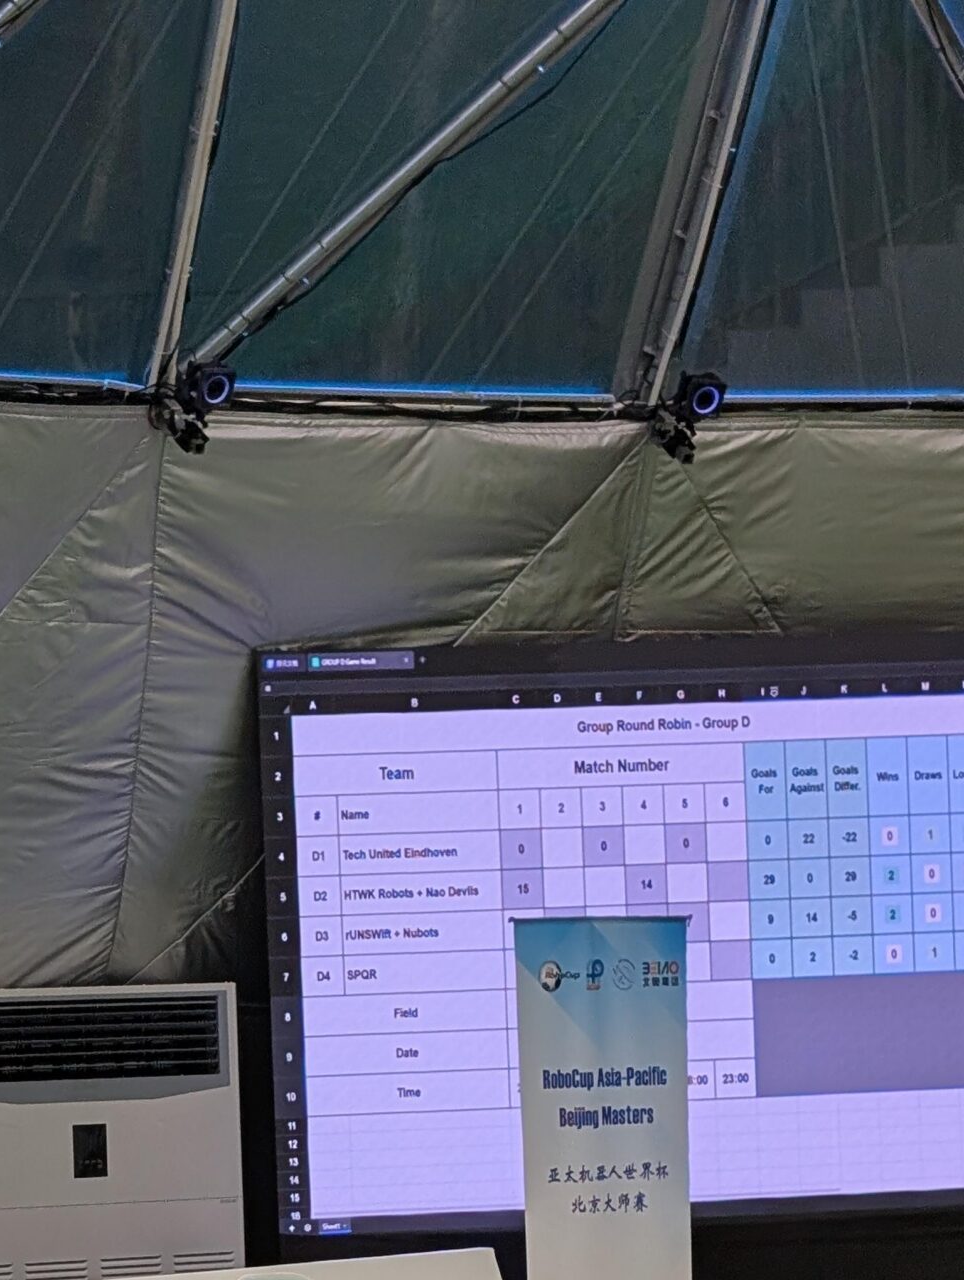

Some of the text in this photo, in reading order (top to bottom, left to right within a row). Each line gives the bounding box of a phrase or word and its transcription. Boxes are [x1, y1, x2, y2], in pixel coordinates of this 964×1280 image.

[800, 685, 806, 696] J
[841, 684, 848, 694] K
[882, 683, 888, 693] L
[921, 681, 930, 691] M
[554, 693, 561, 702] D
[596, 692, 602, 701] E
[637, 690, 643, 700] F
[677, 690, 685, 699] G
[718, 689, 726, 698] H
[411, 698, 418, 707] B
[512, 694, 520, 704] C
[309, 701, 316, 710] A
[577, 721, 613, 734] Group
[617, 719, 654, 732] Round
[658, 718, 692, 730] Robin
[702, 717, 738, 730] Group
[741, 716, 750, 727] D
[274, 732, 279, 740] 1
[574, 758, 669, 774] Match Number
[833, 766, 859, 776] Goals
[275, 772, 282, 781] 2
[379, 766, 414, 780] Team
[751, 768, 777, 779] Goals
[792, 767, 818, 777] Goals
[876, 771, 899, 782] Wins
[914, 770, 942, 781] Draws
[758, 784, 774, 794] For
[789, 782, 824, 795] Against
[834, 781, 861, 792] Differ.
[600, 801, 606, 812] 3
[641, 800, 647, 810] 4
[682, 798, 688, 808] 5
[723, 797, 729, 807] 6
[517, 804, 522, 814] 1
[558, 803, 564, 813] 2
[277, 812, 283, 822] 3
[341, 809, 369, 821] Name
[765, 835, 771, 845] 0
[803, 834, 815, 844] 22
[842, 832, 857, 843] -22
[887, 831, 893, 841] 0
[928, 830, 933, 840] 1
[601, 841, 607, 851] 0
[683, 838, 689, 848] 0
[343, 847, 458, 860] Tech United Eindhoven
[519, 844, 525, 854] 0
[278, 852, 284, 861] 4
[312, 851, 325, 861] D1
[807, 873, 813, 883] 0
[845, 871, 857, 882] 29
[888, 870, 895, 881] 2
[929, 868, 935, 879] 0
[763, 874, 775, 885] 29
[517, 884, 529, 894] 15
[641, 880, 652, 890] 14
[280, 892, 286, 901] 5
[314, 891, 327, 901] D2
[344, 889, 376, 900] HTWK
[378, 888, 414, 899] Robots
[426, 887, 445, 898] Nao
[448, 886, 478, 897] Devils
[806, 912, 818, 923] 14
[848, 911, 857, 921] -5
[890, 909, 896, 920] 2
[930, 908, 936, 918] 0
[767, 914, 774, 924] 9
[281, 932, 288, 942] 6
[316, 931, 329, 941] D3
[346, 928, 392, 940] rUNSWift
[403, 927, 438, 938] Nubots
[810, 952, 816, 962] 2
[849, 950, 859, 960] -2
[891, 949, 897, 959] 0
[933, 948, 937, 958] 1
[769, 954, 775, 964] 0
[283, 972, 290, 982] 7
[317, 971, 330, 981] D4
[347, 969, 377, 980] SPQR
[284, 1012, 291, 1022] 8
[394, 1008, 418, 1018] Field
[286, 1052, 292, 1062] 9
[396, 1048, 419, 1058] Date
[542, 1068, 594, 1091] RoboCup
[597, 1066, 667, 1087] Asia-Pacific
[687, 1075, 708, 1085] 8:00
[723, 1073, 749, 1084] 23:00
[286, 1092, 296, 1102] 10
[397, 1087, 421, 1098] Time
[559, 1105, 654, 1129] Beijing Masters
[288, 1122, 296, 1130] 11
[288, 1140, 297, 1149] 12
[289, 1158, 298, 1167] 13
[548, 1161, 669, 1184] 亚太机器人世界杯
[289, 1176, 299, 1185] 14
[290, 1193, 300, 1202] 15
[572, 1192, 648, 1214] 北京大师赛
